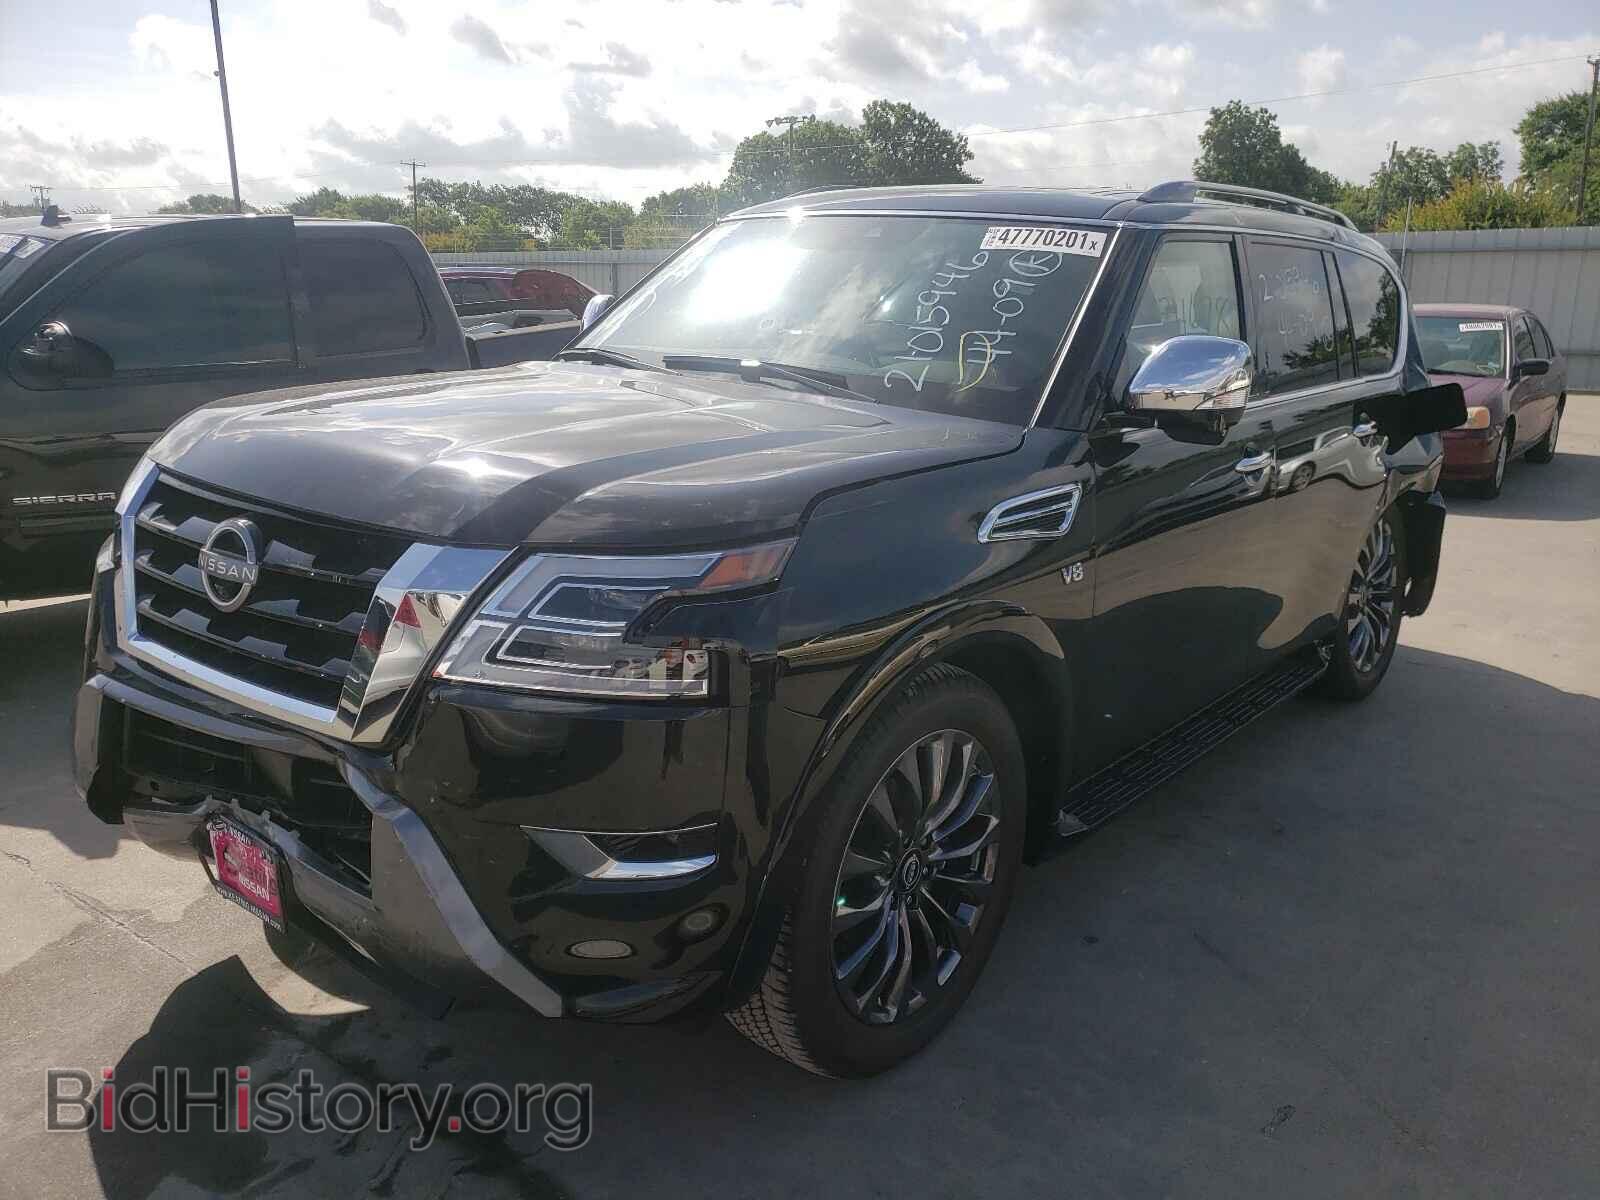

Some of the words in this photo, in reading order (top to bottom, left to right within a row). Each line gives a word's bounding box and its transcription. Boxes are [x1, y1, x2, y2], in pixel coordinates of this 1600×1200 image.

[998, 228, 1089, 250] 47770201
[12, 492, 116, 506] SIERRA
[198, 552, 256, 584] NISSAN
[1061, 562, 1084, 585] V8
